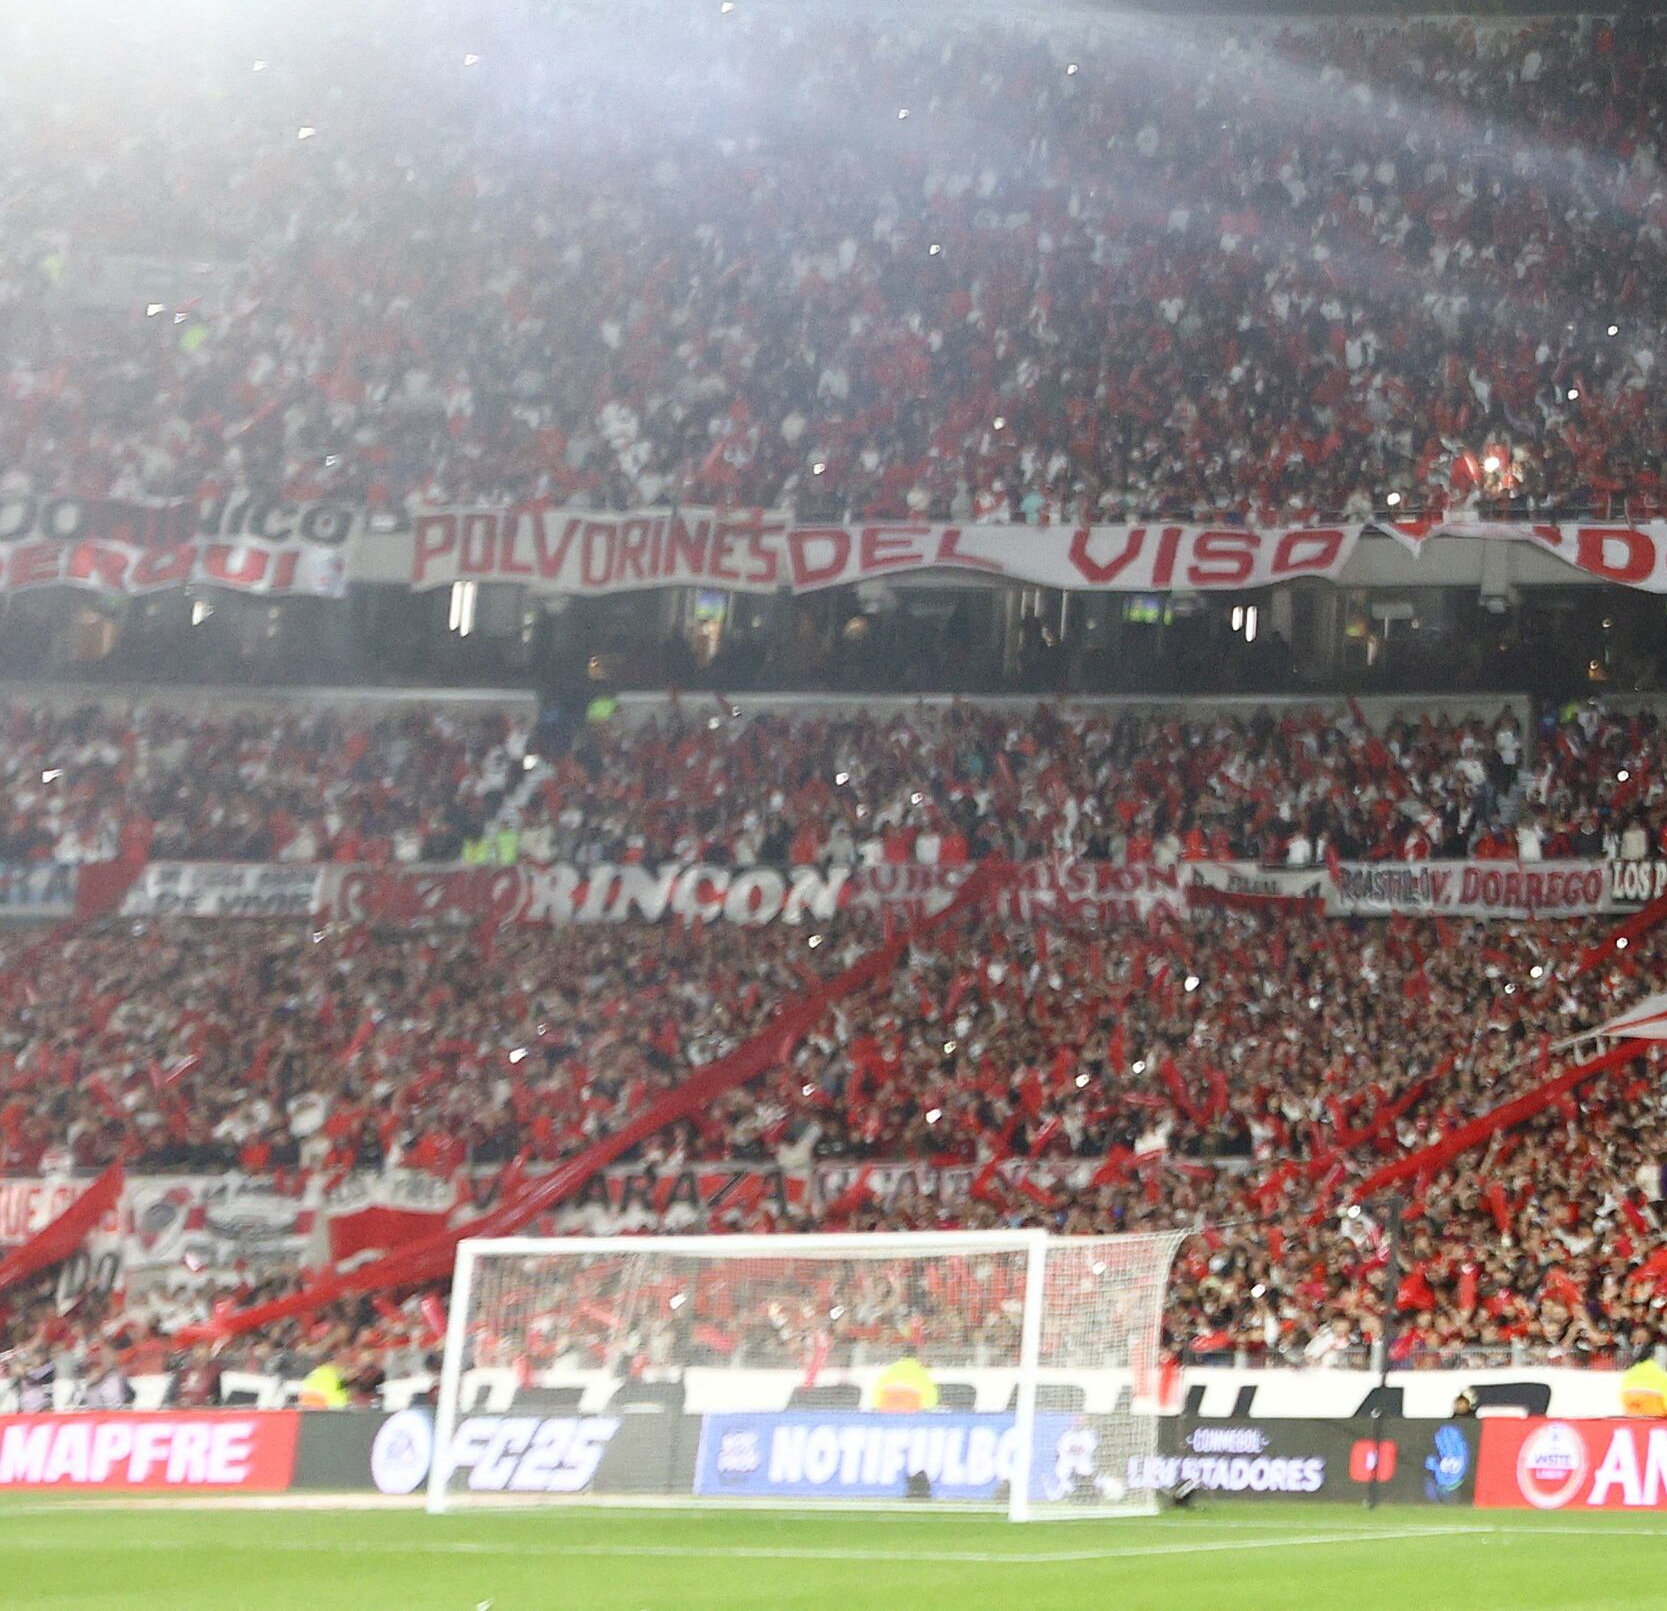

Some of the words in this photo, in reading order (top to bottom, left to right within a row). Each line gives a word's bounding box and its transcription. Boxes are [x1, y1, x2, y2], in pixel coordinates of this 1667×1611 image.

[412, 509, 780, 587] POLVORINES
[786, 524, 996, 585] DEL
[1066, 526, 1346, 586] VISO
[525, 865, 852, 926] RINCON
[1461, 867, 1602, 907] DORREGO
[1612, 860, 1652, 901] LOS
[1, 1420, 255, 1484] MAPFRE
[446, 1416, 620, 1491] FC25
